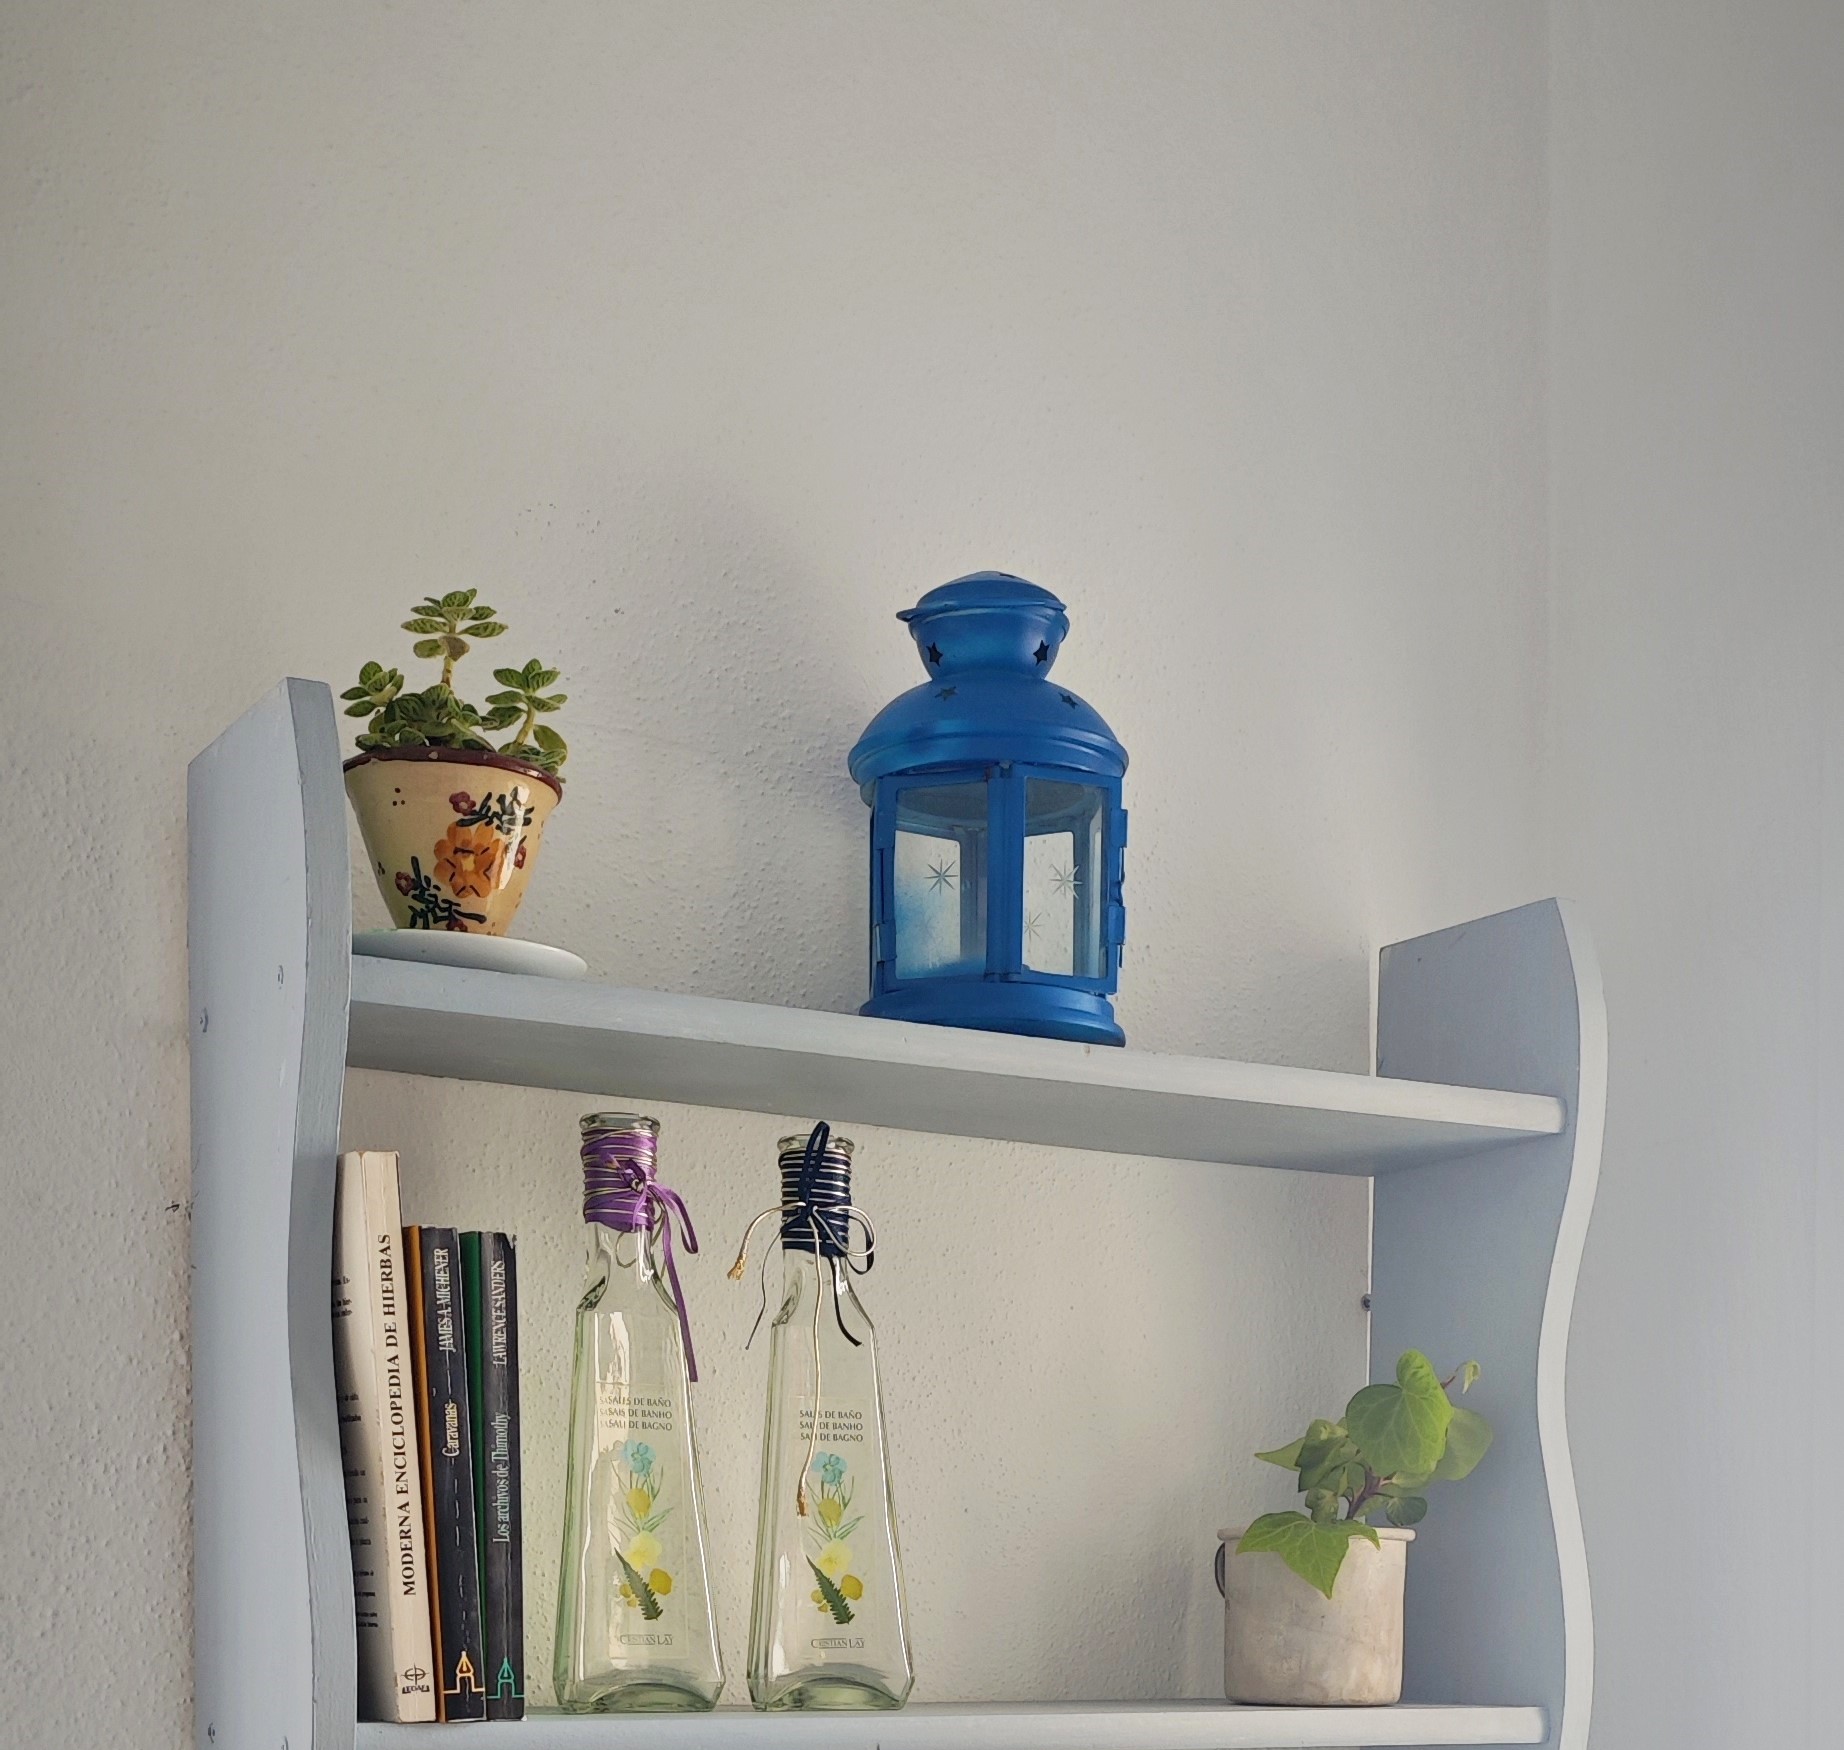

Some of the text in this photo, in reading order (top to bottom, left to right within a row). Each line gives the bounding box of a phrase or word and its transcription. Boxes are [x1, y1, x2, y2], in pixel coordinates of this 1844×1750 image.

[433, 1248, 452, 1305] MICHENER
[490, 1260, 508, 1367] LAWRENCE SANDERS
[437, 1317, 457, 1353] JAMES
[628, 1408, 639, 1418] DE
[641, 1409, 673, 1420] BANHO
[634, 1397, 645, 1406] DE
[647, 1397, 672, 1408] BAÑO
[800, 1409, 863, 1420] SALS DE BAÑO
[378, 1234, 416, 1596] MODERNA ENCICLOPEDIA DE HIERBAS
[628, 1420, 640, 1429] DE
[641, 1421, 673, 1431] BAGNO
[819, 1421, 830, 1430] DE
[832, 1422, 864, 1431] BANHO
[441, 1403, 460, 1457] Caravanas
[819, 1432, 831, 1442] DE
[832, 1433, 864, 1443] BAGNO
[490, 1412, 512, 1543] Los archivos de Thimothy
